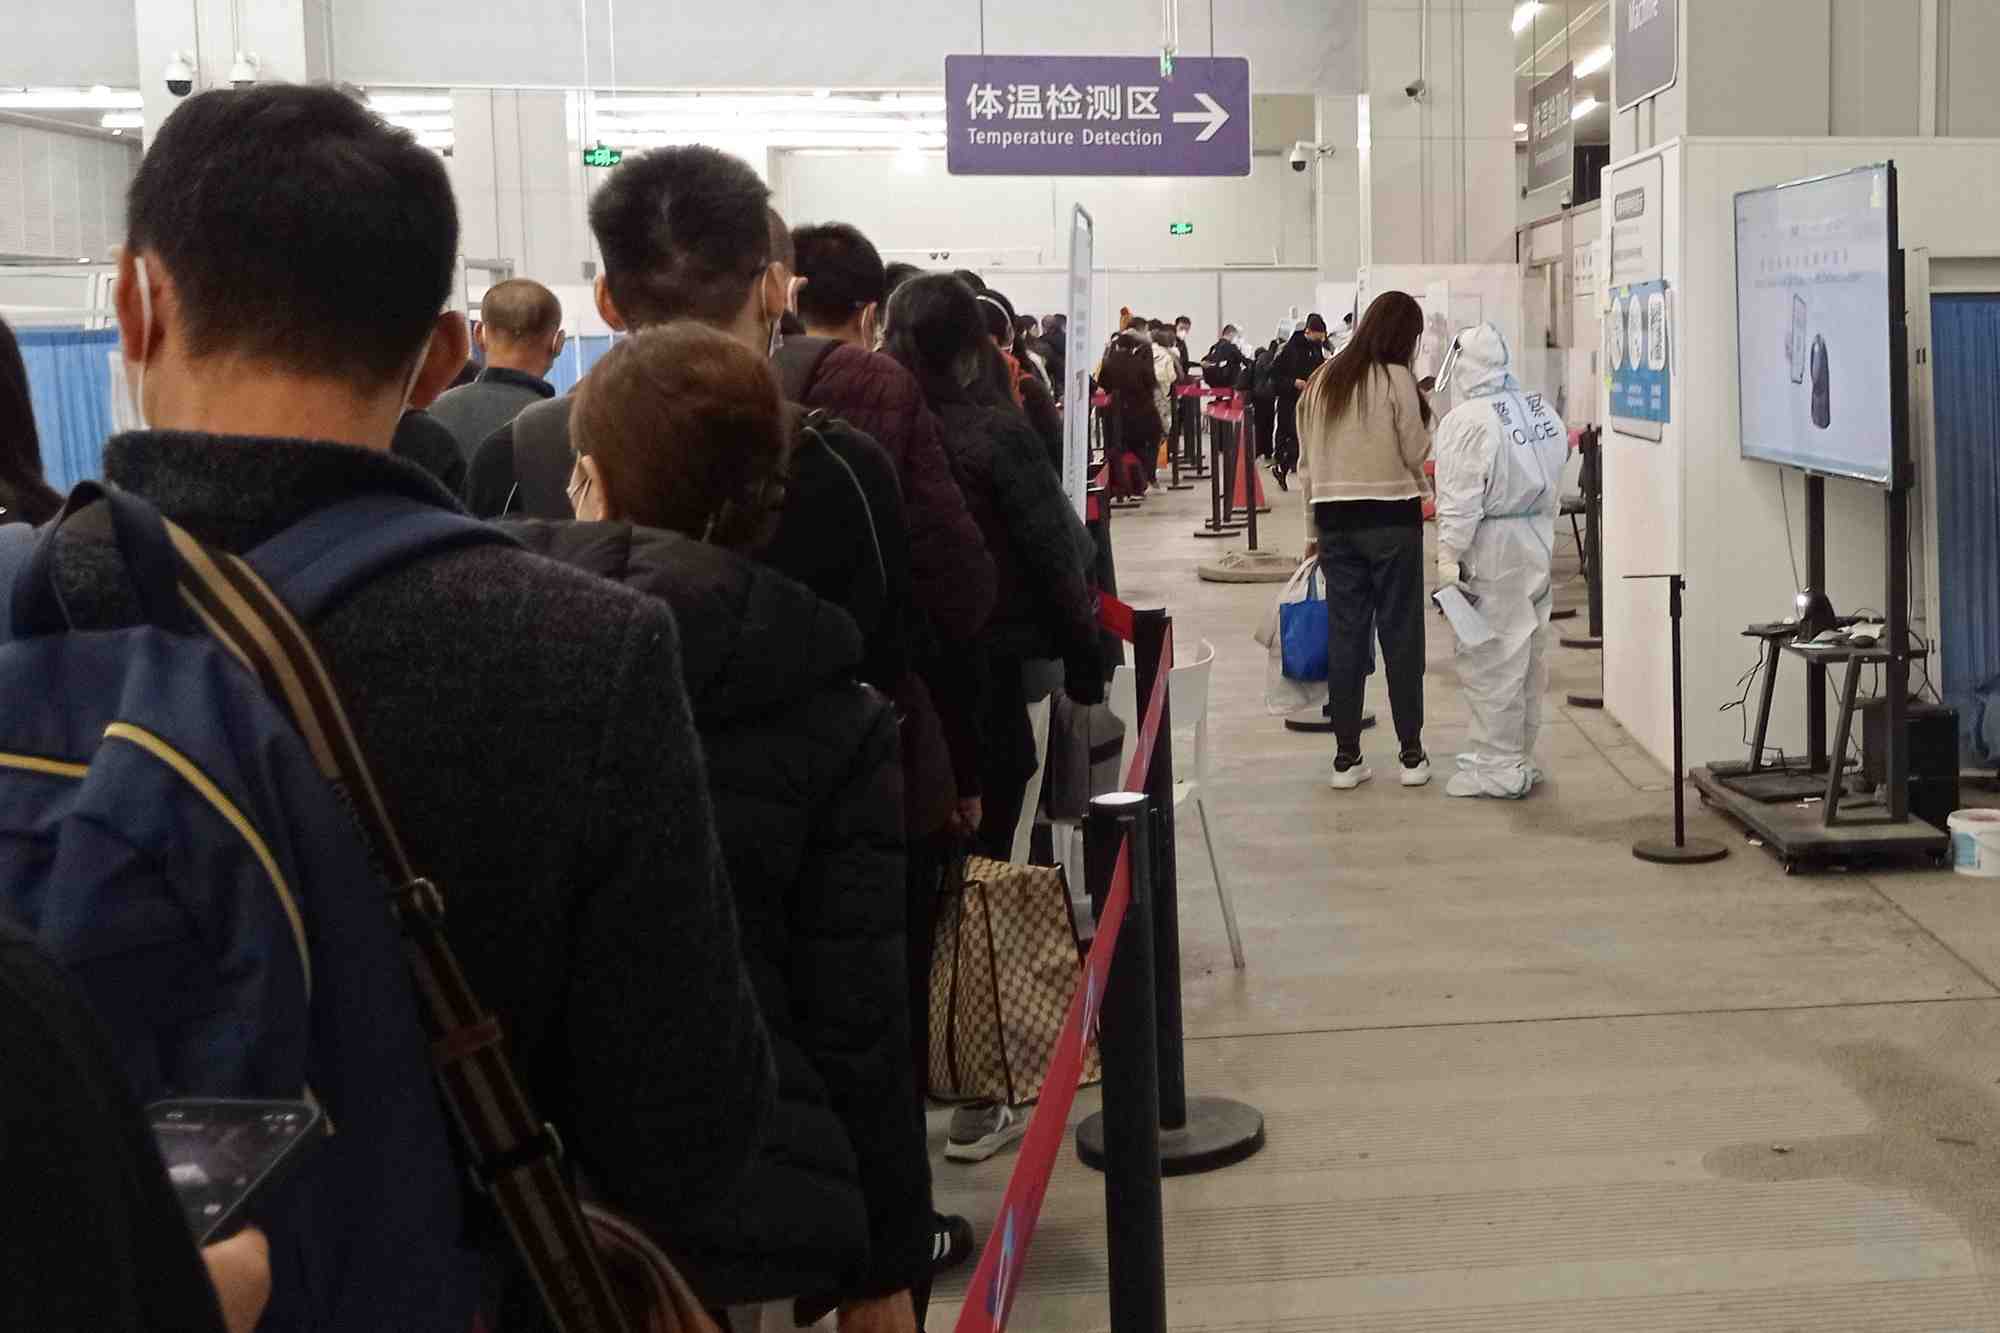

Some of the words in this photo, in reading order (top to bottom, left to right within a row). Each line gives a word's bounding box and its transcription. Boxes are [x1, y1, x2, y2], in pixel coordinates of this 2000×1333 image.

[966, 83, 1161, 120] 体温检测区
[967, 128, 1074, 148] Temperature
[1082, 127, 1162, 146] Detection
